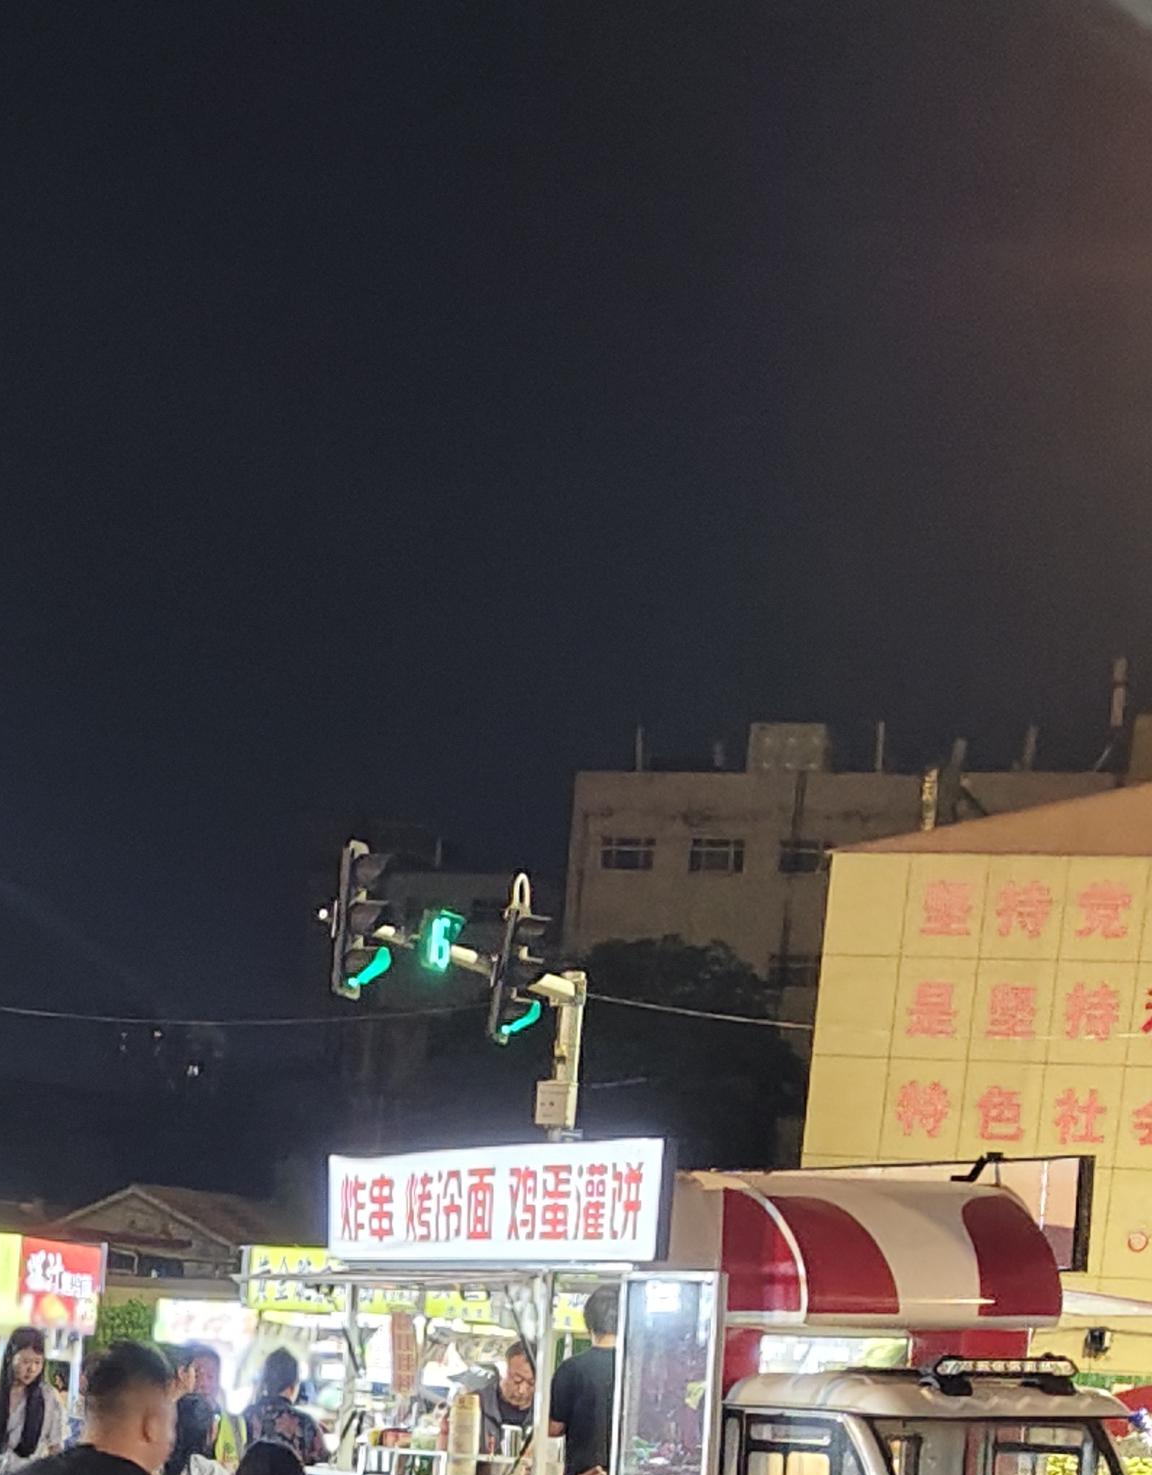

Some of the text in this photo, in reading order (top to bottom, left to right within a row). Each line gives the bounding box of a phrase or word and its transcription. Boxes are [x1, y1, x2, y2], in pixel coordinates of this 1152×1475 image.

[920, 880, 1132, 940] 坚持党
[905, 979, 1152, 1042] 是坚持
[340, 1161, 645, 1242] 炸串 烤冷面 鸡蛋灌饼
